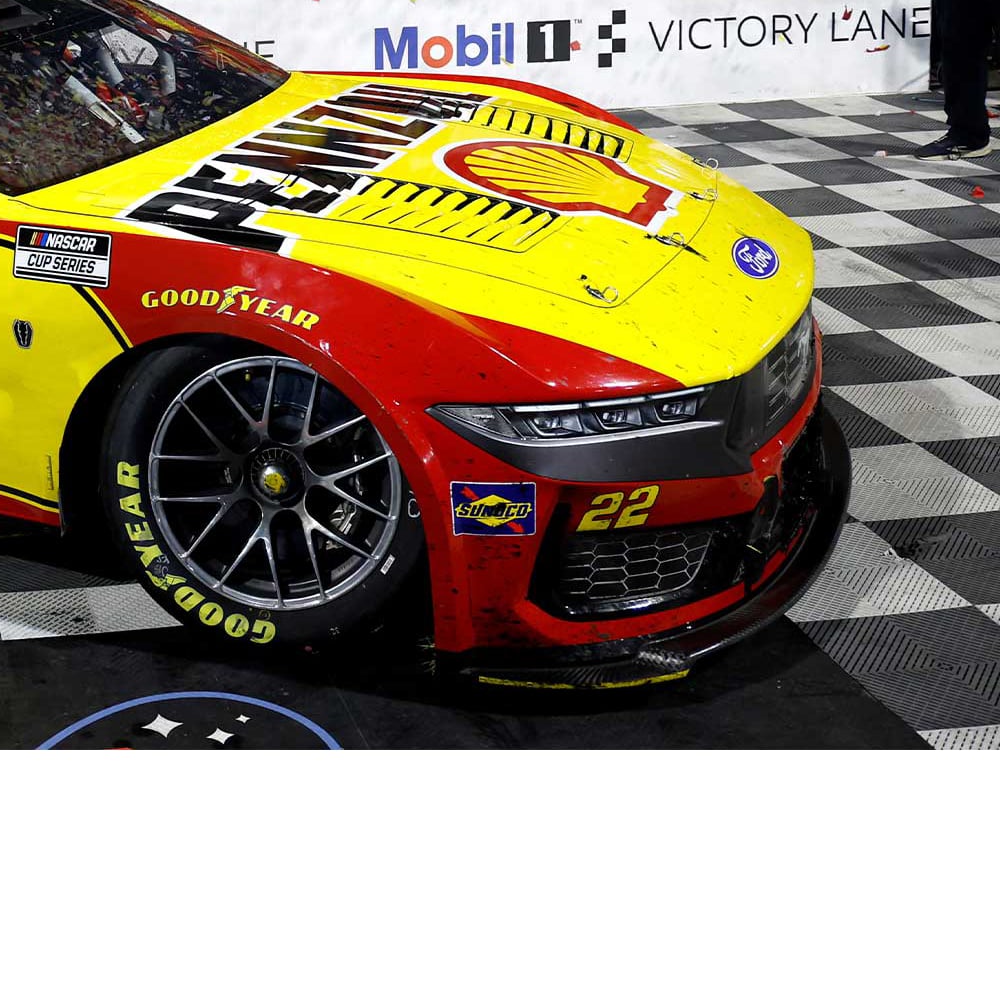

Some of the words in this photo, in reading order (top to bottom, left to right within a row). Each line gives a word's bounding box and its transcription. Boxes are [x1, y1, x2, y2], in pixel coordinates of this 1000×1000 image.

[375, 22, 515, 70] Mobil
[648, 12, 818, 52] VICTORY
[831, 6, 931, 43] LANE
[127, 83, 495, 254] PENNZOIL
[44, 232, 97, 252] NASCAR
[27, 254, 52, 268] CUP
[52, 257, 96, 273] SERIES
[737, 246, 773, 275] Ford
[457, 503, 531, 518] SUNOCO
[576, 485, 659, 531] 22
